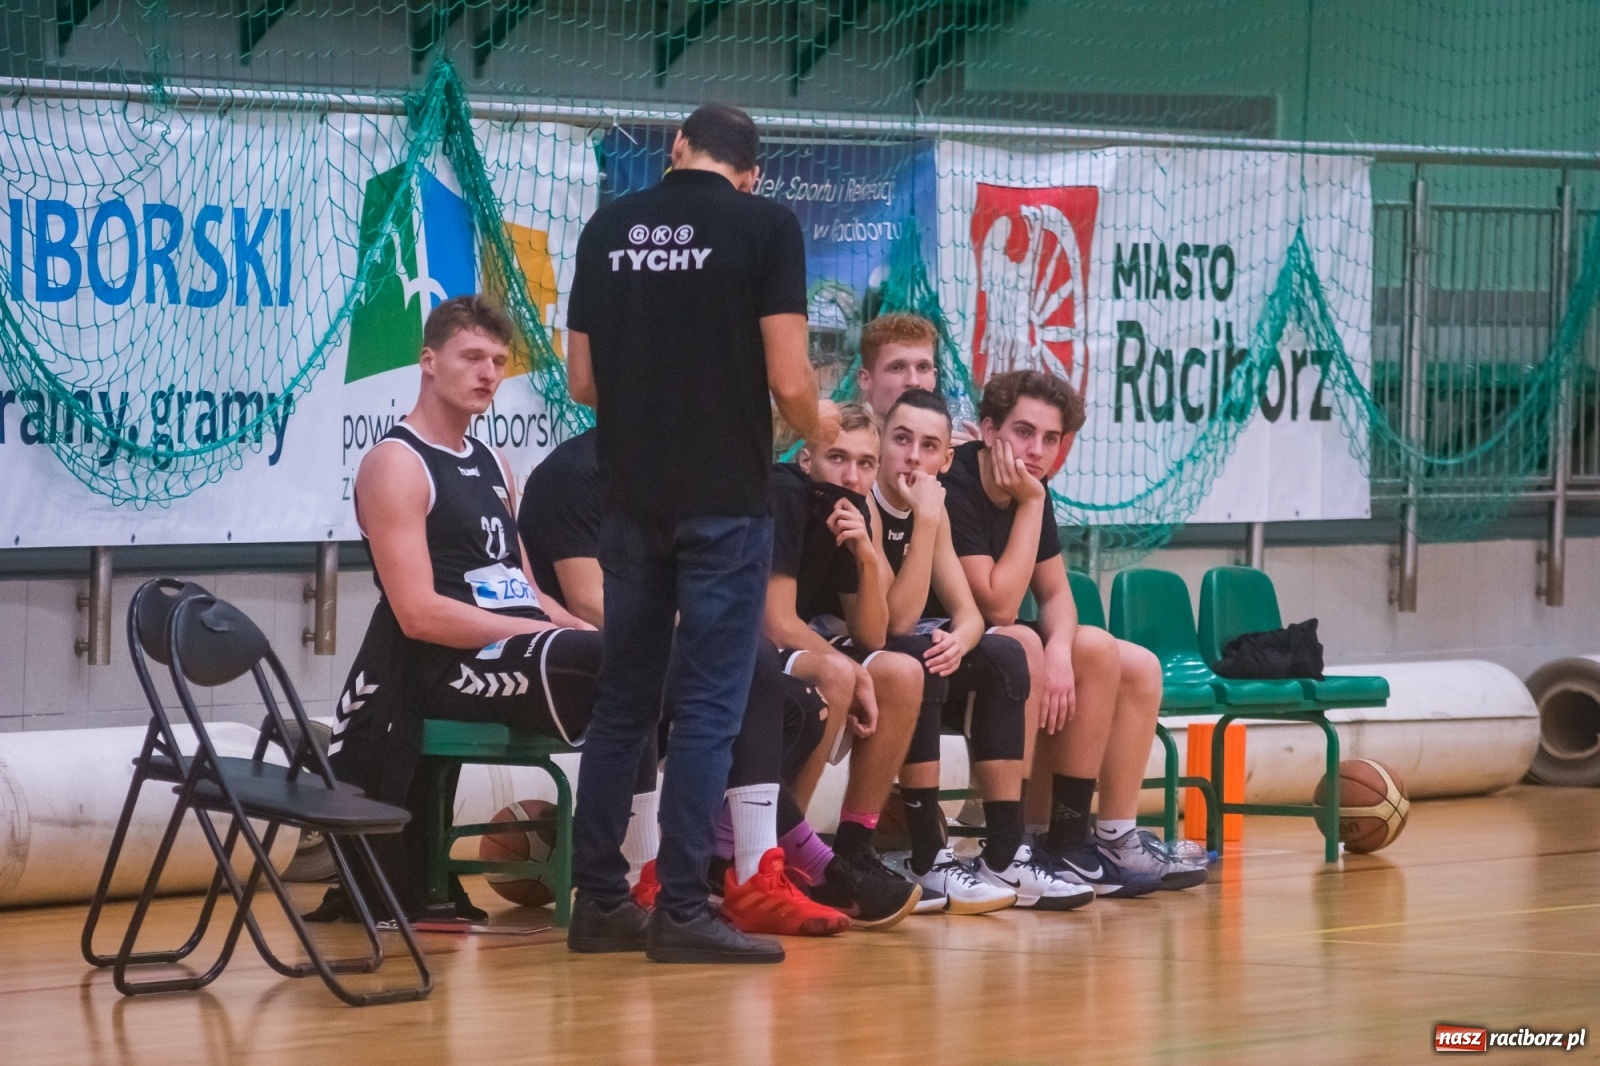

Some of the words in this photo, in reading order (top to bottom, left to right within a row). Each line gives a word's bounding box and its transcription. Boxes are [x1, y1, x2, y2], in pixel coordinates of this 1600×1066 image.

[786, 176, 834, 203] Sportu
[628, 224, 694, 246] GKS
[813, 223, 830, 241] w
[608, 248, 712, 272] TYCHY
[1113, 243, 1235, 300] MIASTO
[1113, 318, 1333, 423] Raciborz
[150, 384, 294, 471] gramy
[342, 398, 408, 465] powi
